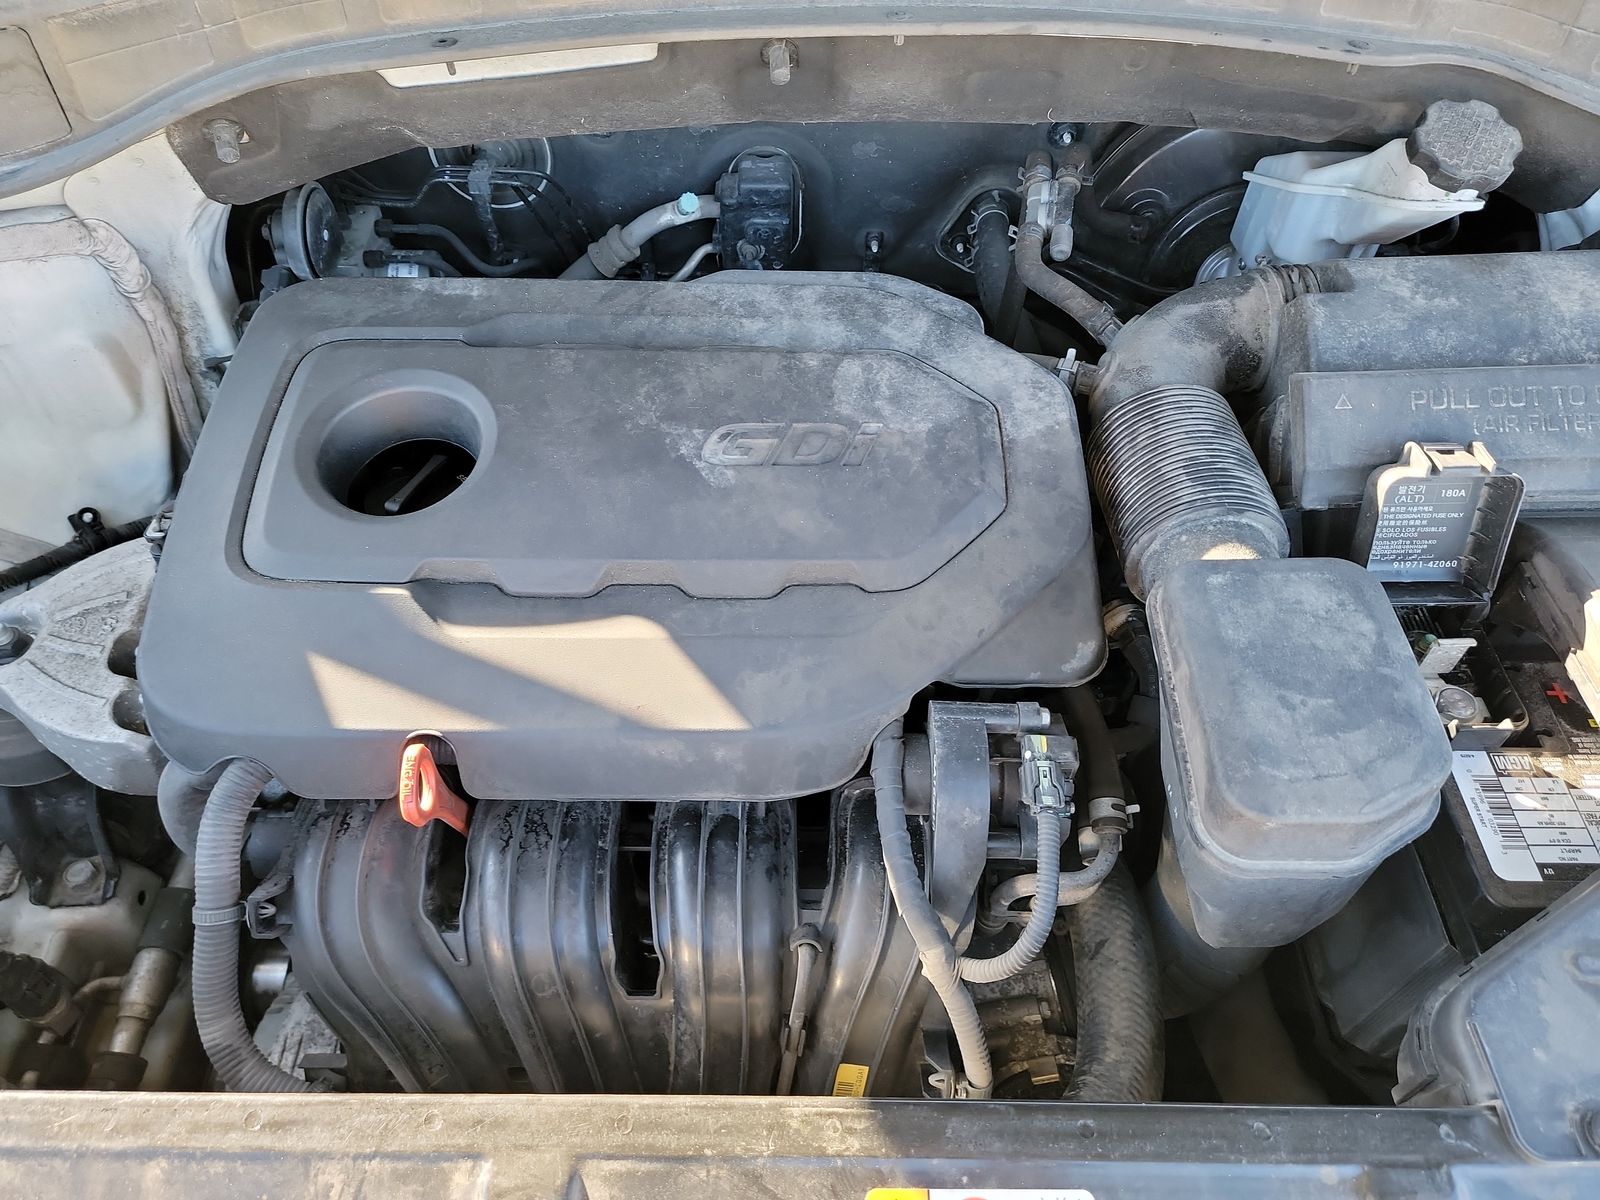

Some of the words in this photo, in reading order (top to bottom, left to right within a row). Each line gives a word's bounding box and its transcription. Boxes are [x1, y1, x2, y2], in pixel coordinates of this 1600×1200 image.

[1411, 388, 1480, 410] PULL
[1488, 386, 1543, 407] OUT
[1553, 385, 1585, 408] TO
[1398, 485, 1426, 494] 발전기
[1441, 489, 1466, 497] 180A
[1395, 495, 1425, 504] (ALT)
[1393, 560, 1458, 569] 91971-4Z060
[1493, 755, 1531, 770] AGM
[1543, 867, 1555, 875] 12V
